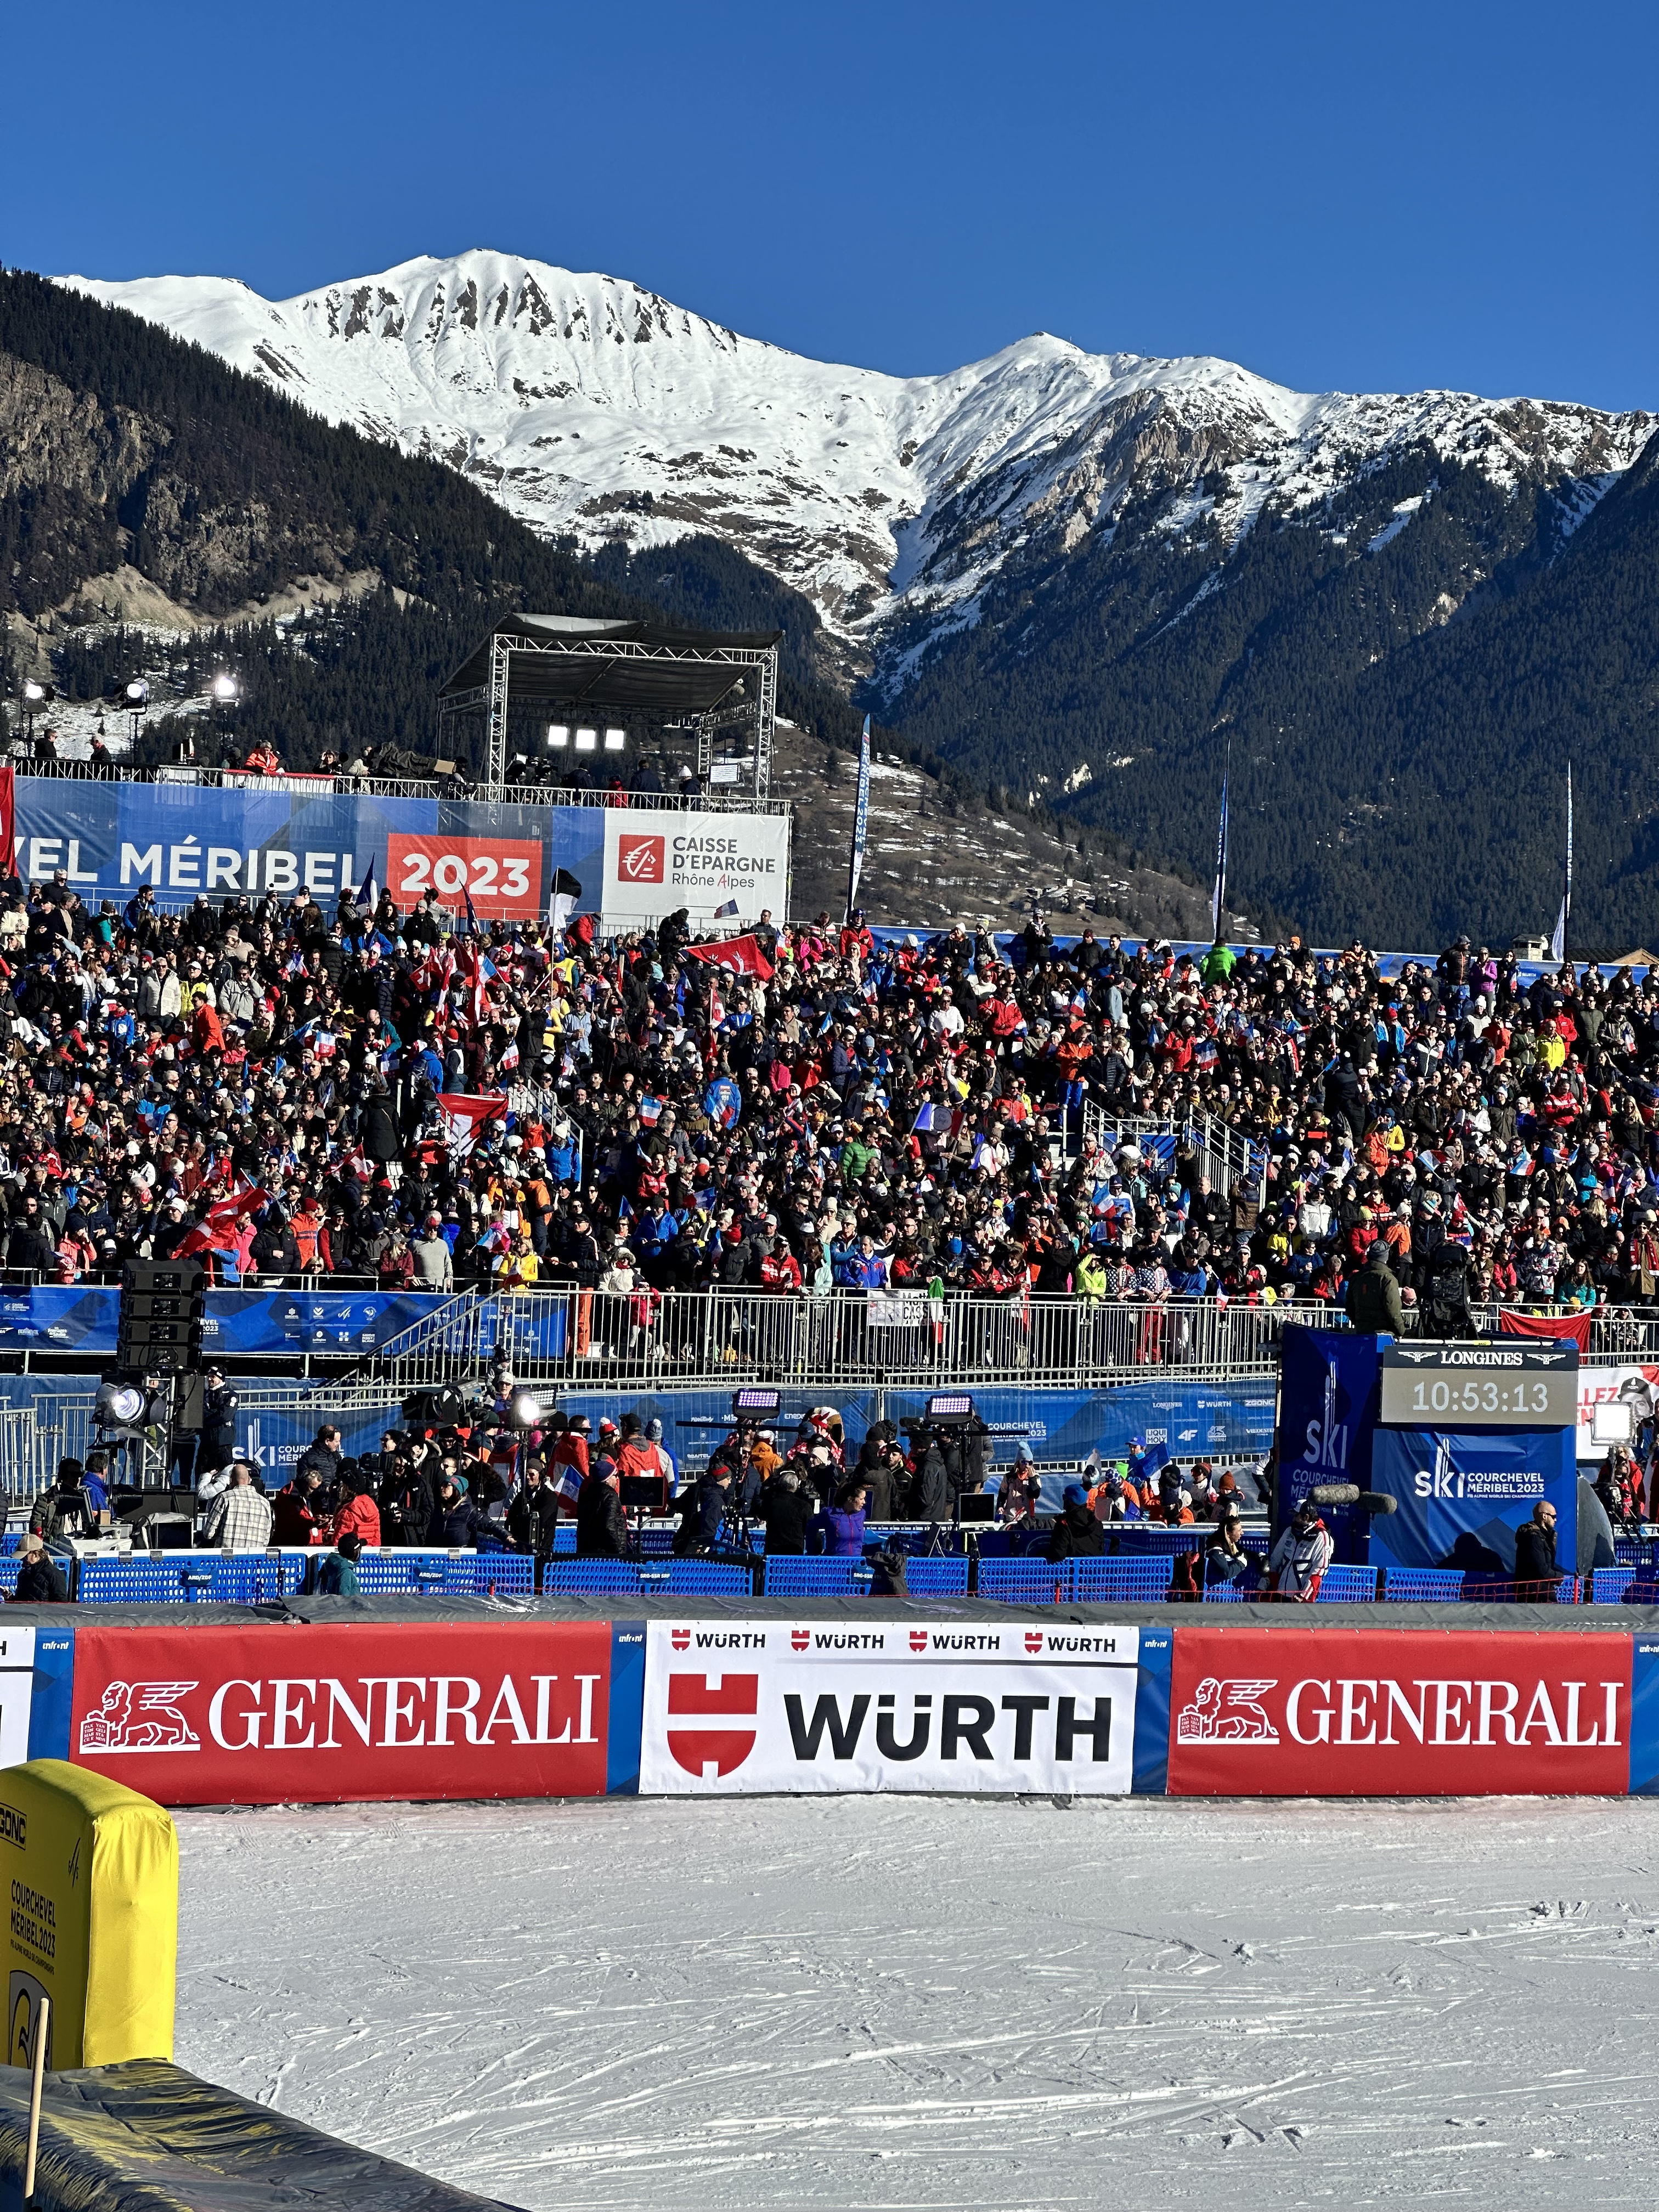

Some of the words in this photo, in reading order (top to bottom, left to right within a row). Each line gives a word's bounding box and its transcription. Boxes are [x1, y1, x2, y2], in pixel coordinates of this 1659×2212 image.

[855, 806, 864, 844] 2023
[673, 837, 737, 854] CAISSE
[120, 835, 362, 894] MÉRIBEL
[673, 854, 776, 873] D'EPARGNE
[400, 853, 530, 897] 2023
[673, 873, 714, 885] Rhône
[718, 873, 755, 889] Alpes
[1441, 1351, 1523, 1365] LONGINES
[1413, 1381, 1549, 1413] 10:53:13
[1577, 1387, 1619, 1406] LEZ
[988, 1421, 1047, 1430] COURCHEVEL
[1178, 1430, 1198, 1441] 4F
[1414, 1438, 1465, 1498] SKI
[1468, 1473, 1544, 1482] COURCHEVEL
[1468, 1482, 1516, 1493] MÉRIBEL
[1517, 1483, 1545, 1493] 2023
[695, 1633, 766, 1649] WÜRTH
[815, 1634, 884, 1649] WÜRTH
[933, 1635, 1001, 1650] WÜRTH
[1048, 1637, 1116, 1653] WÜRTH
[208, 1674, 601, 1751] GENERALI
[1286, 1679, 1624, 1747] GENERALI
[783, 1694, 1112, 1762] WÜRTH
[11, 1878, 57, 1928] COURCHEVEL
[10, 1906, 39, 1948] MÉRIBEL
[39, 1926, 55, 1959] 2023
